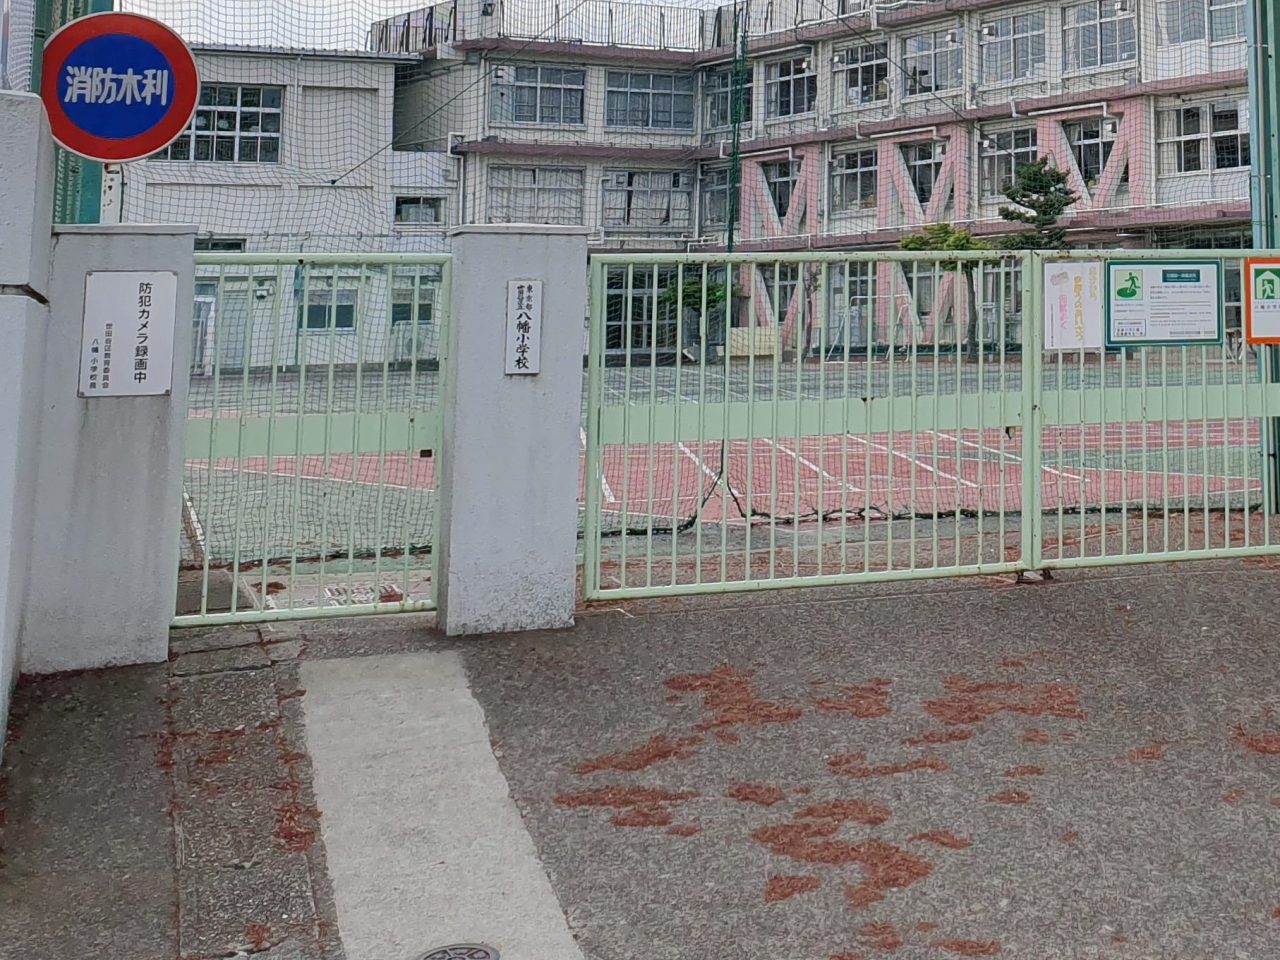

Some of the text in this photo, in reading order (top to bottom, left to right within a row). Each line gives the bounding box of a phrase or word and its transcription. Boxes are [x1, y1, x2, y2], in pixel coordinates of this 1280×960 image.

[64, 65, 168, 106] 消防水利
[134, 282, 153, 384] 防犯カメラ録画中
[514, 311, 532, 369] 八幡小学校
